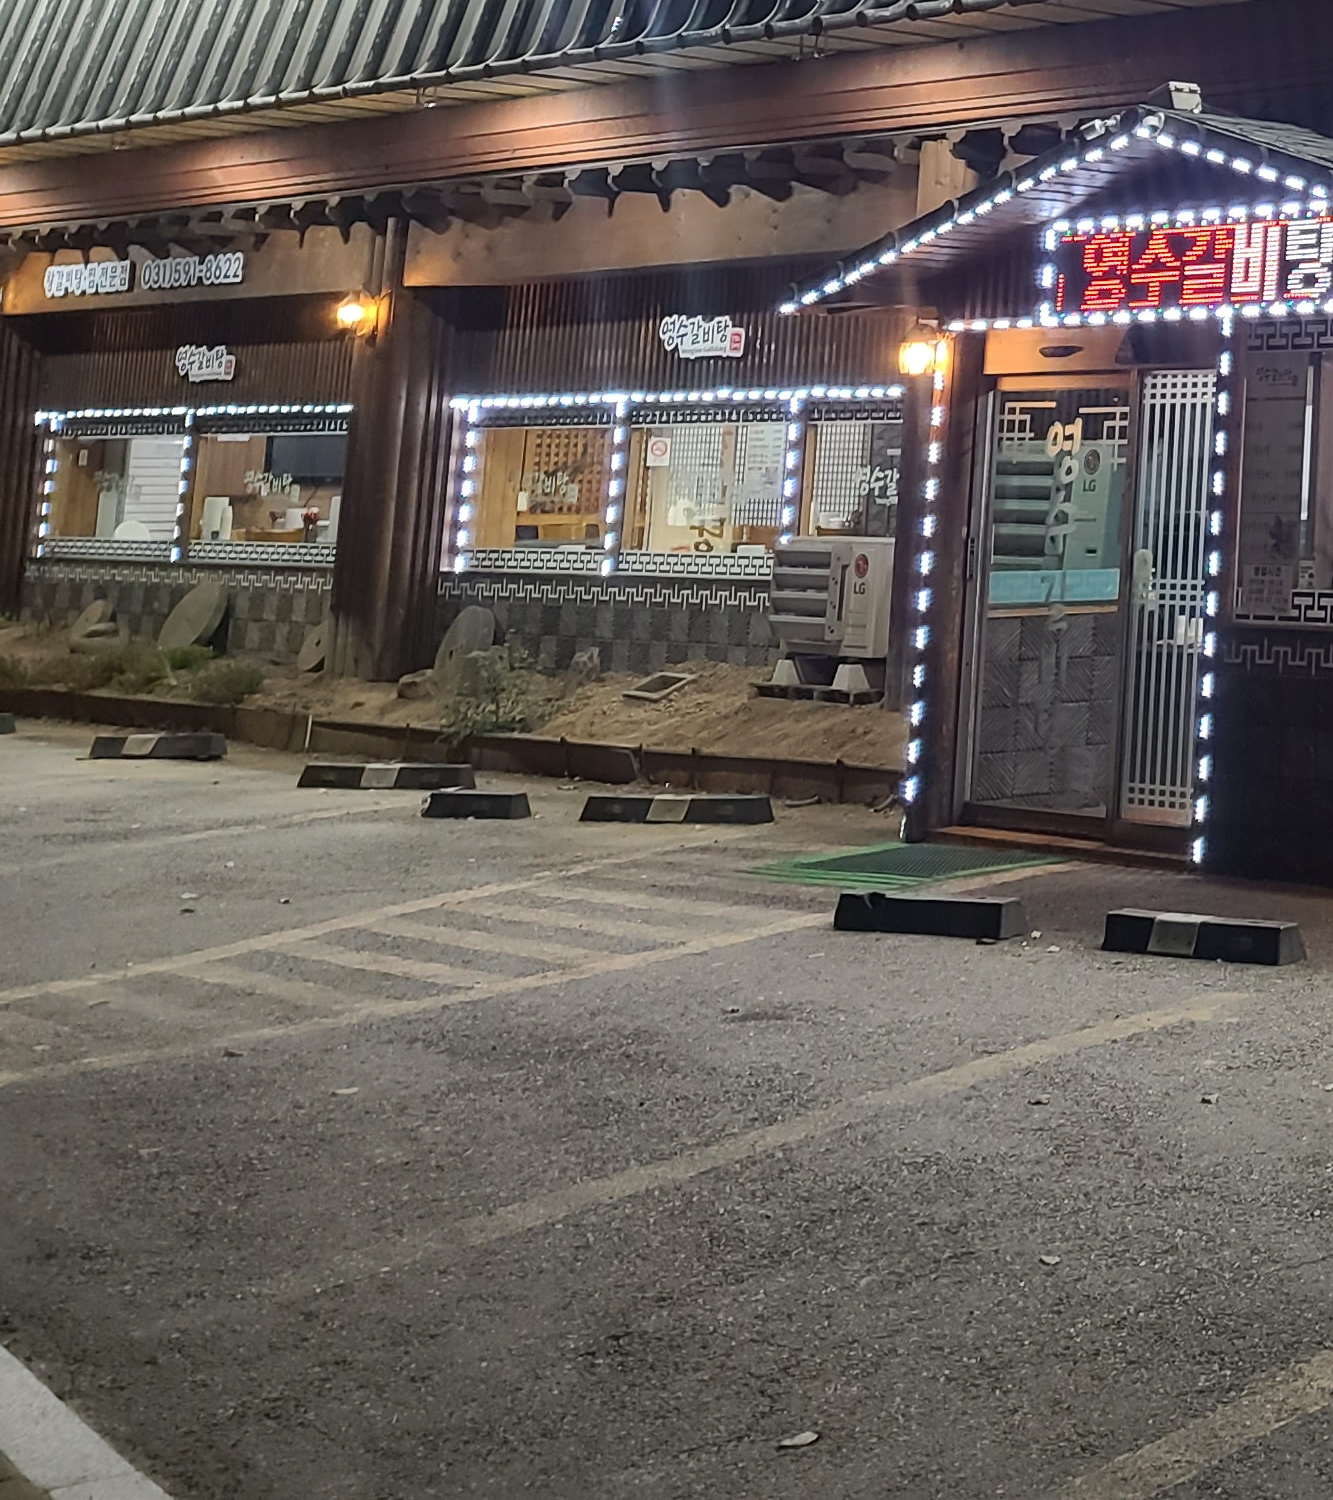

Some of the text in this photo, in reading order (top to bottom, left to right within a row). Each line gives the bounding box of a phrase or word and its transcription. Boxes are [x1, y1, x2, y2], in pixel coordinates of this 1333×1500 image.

[99, 261, 128, 289] 전문점
[143, 254, 241, 288] 031)591-8622
[661, 319, 730, 347] 영수갈비탕
[177, 347, 225, 372] 영수갈비탕
[1082, 479, 1096, 492] LG
[852, 581, 866, 595] LG
